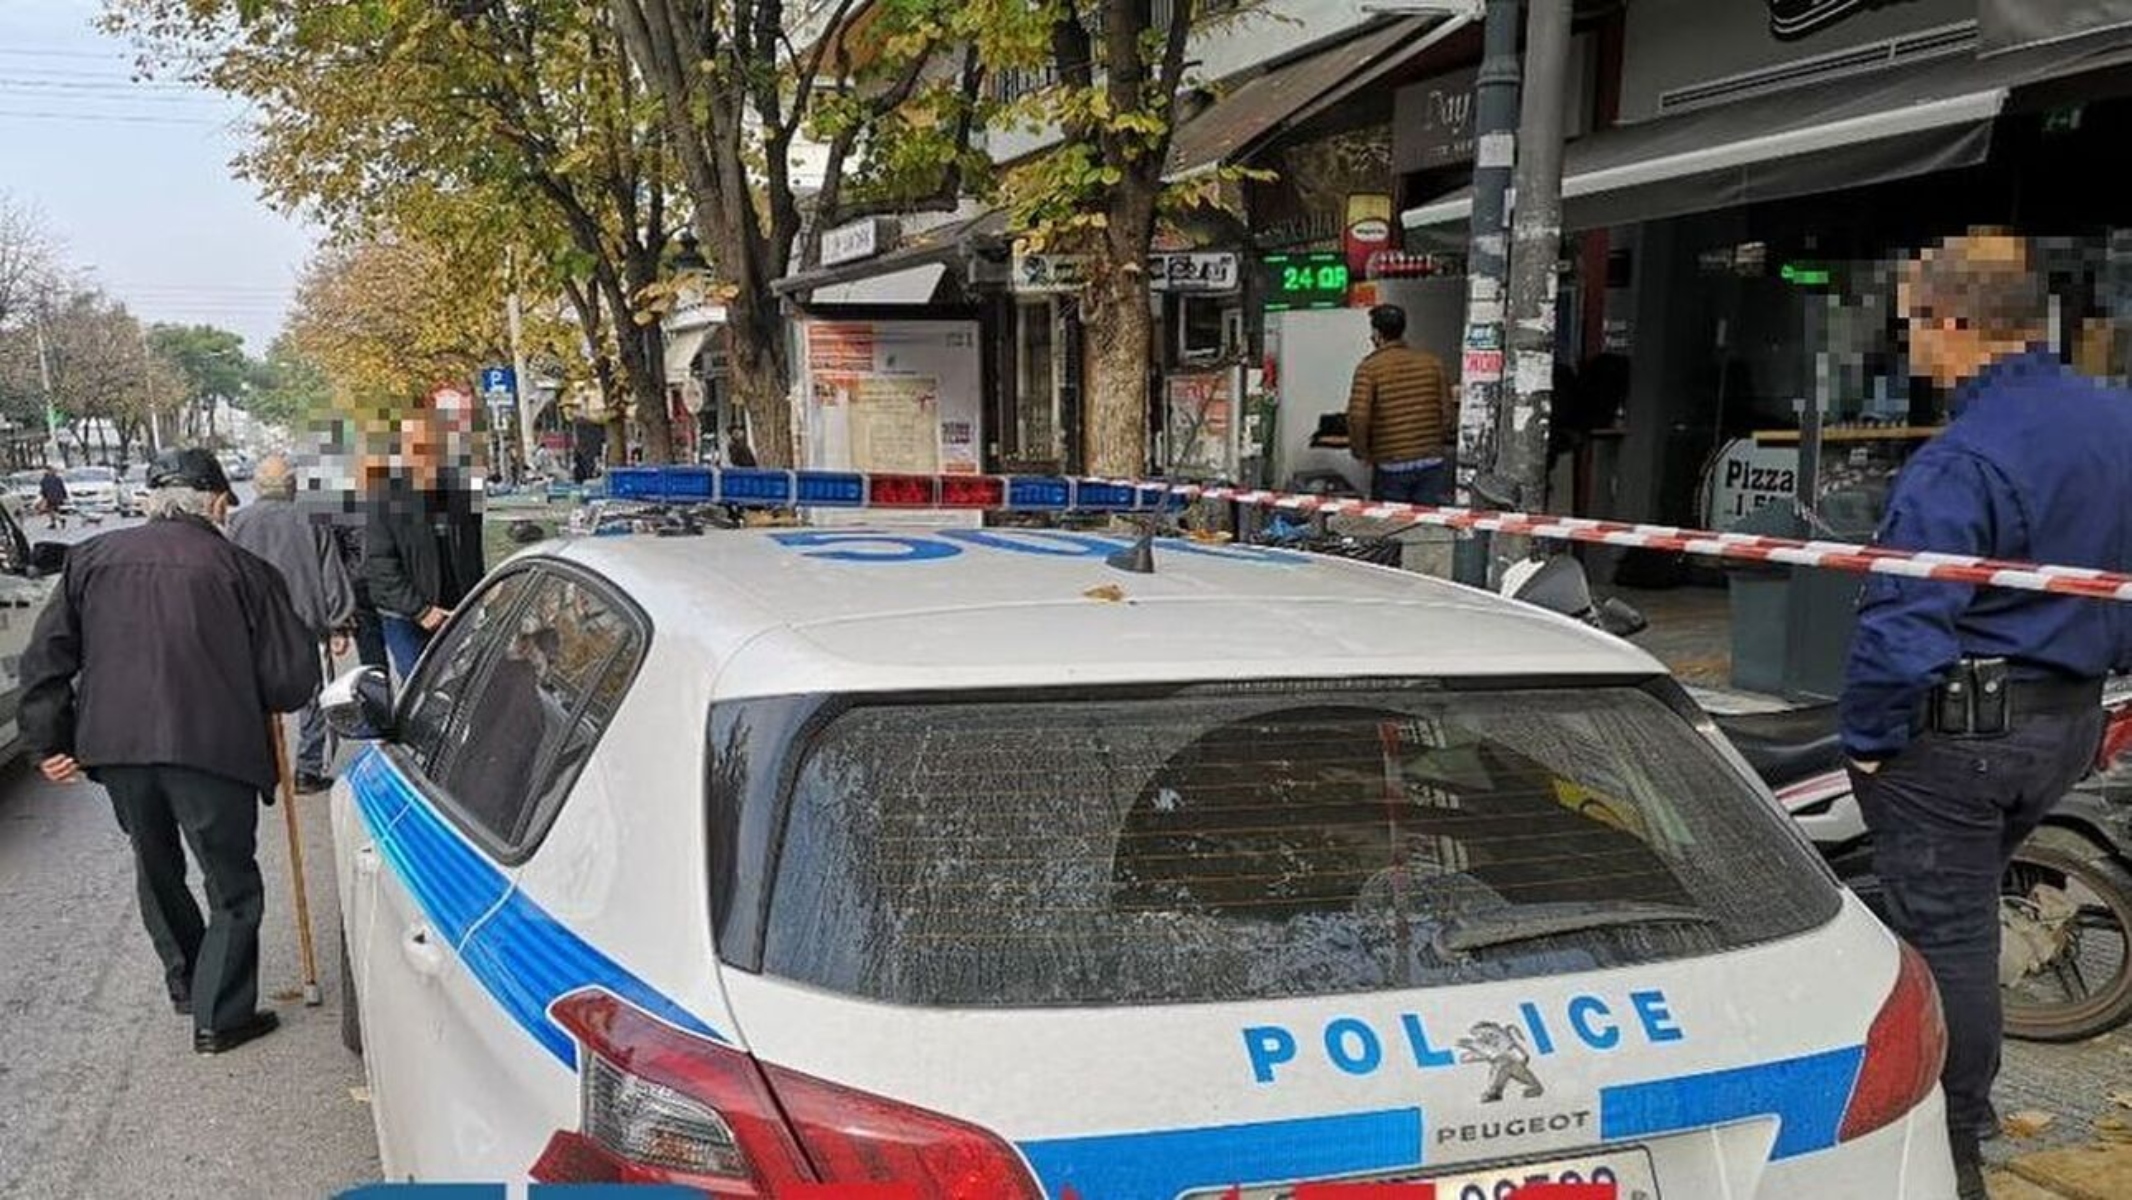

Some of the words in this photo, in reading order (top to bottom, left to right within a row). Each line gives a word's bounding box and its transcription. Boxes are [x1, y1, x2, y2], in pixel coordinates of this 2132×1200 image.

[1284, 266, 1314, 289] 24
[1725, 459, 1795, 493] Pizza
[1242, 989, 1685, 1083] POLICE
[1437, 1110, 1591, 1144] PEUGEOT
